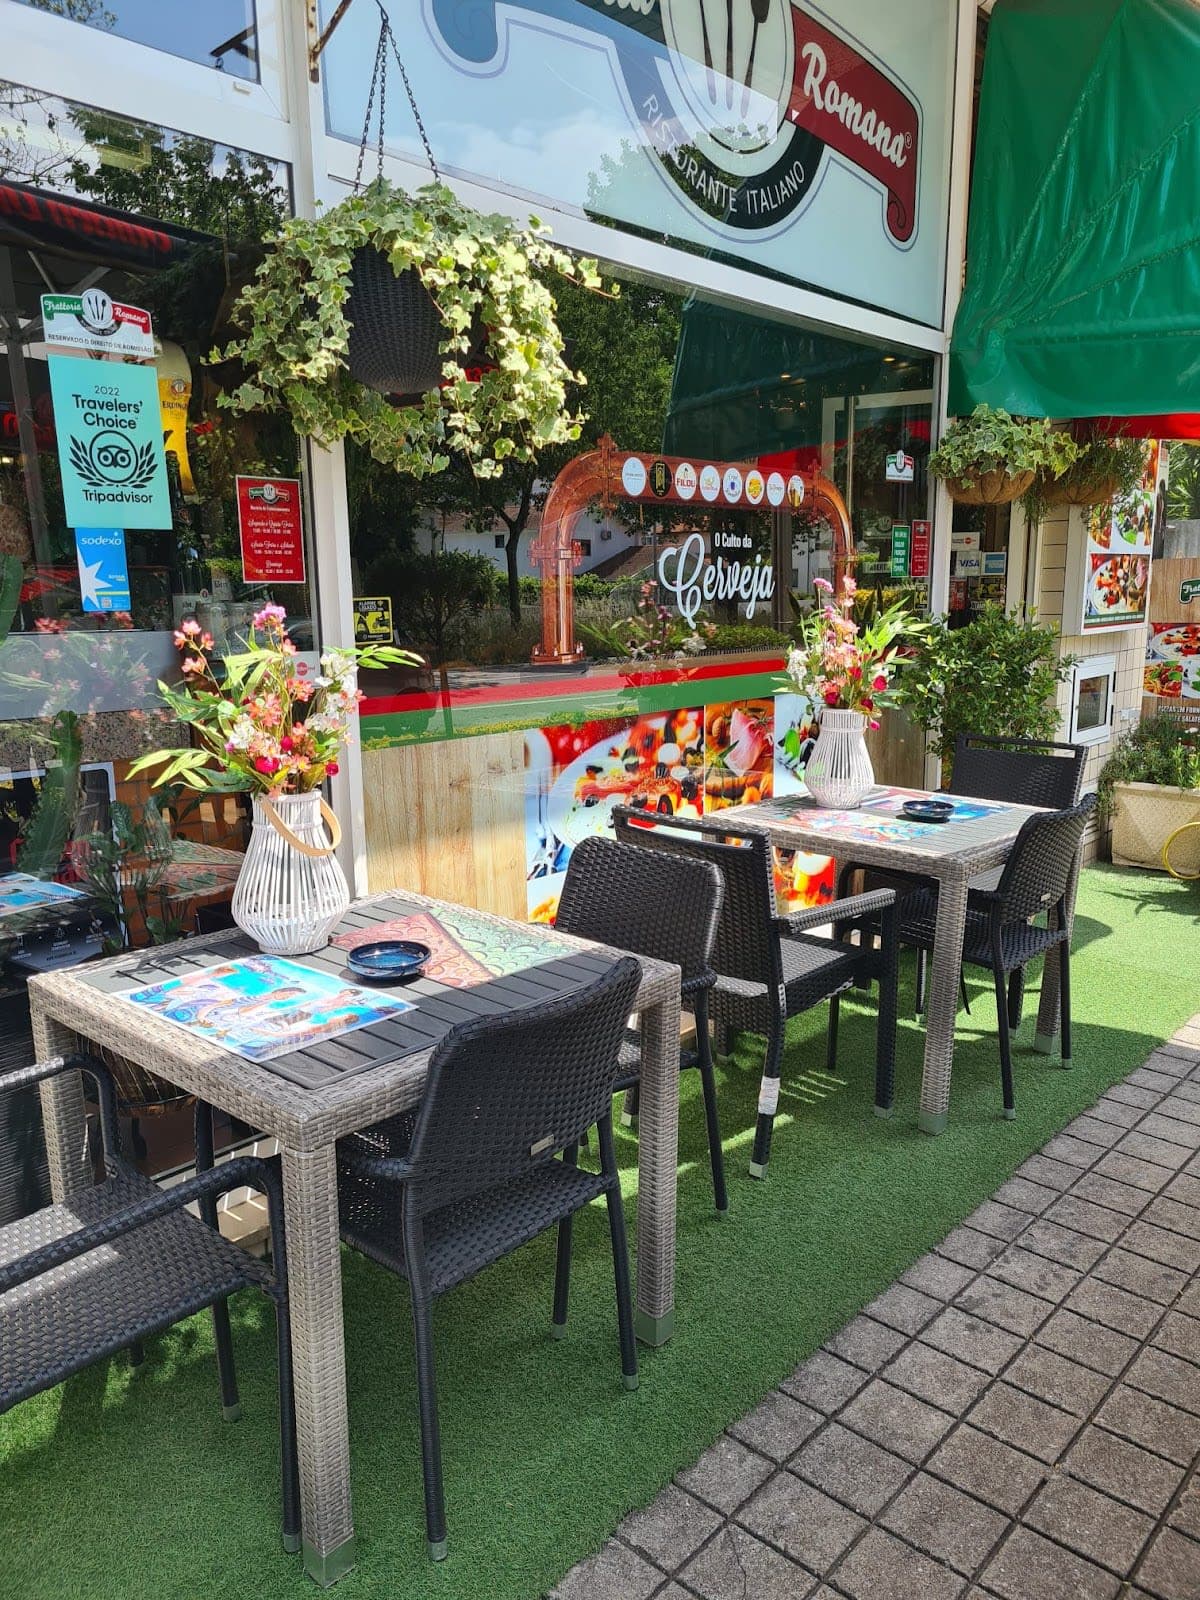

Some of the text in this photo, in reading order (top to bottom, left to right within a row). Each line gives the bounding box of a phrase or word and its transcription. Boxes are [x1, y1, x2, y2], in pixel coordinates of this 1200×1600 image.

[642, 93, 805, 215] RISTORANTE ITALIANO
[94, 385, 120, 396] 2022
[71, 394, 143, 414] Travelers'
[83, 411, 137, 430] Choice
[676, 477, 696, 488] FILOU
[82, 489, 153, 505] Tripadvisor
[81, 535, 122, 546] sodexo
[714, 532, 753, 548] O Culto da
[959, 559, 980, 567] VISA
[658, 532, 776, 630] Cerveja
